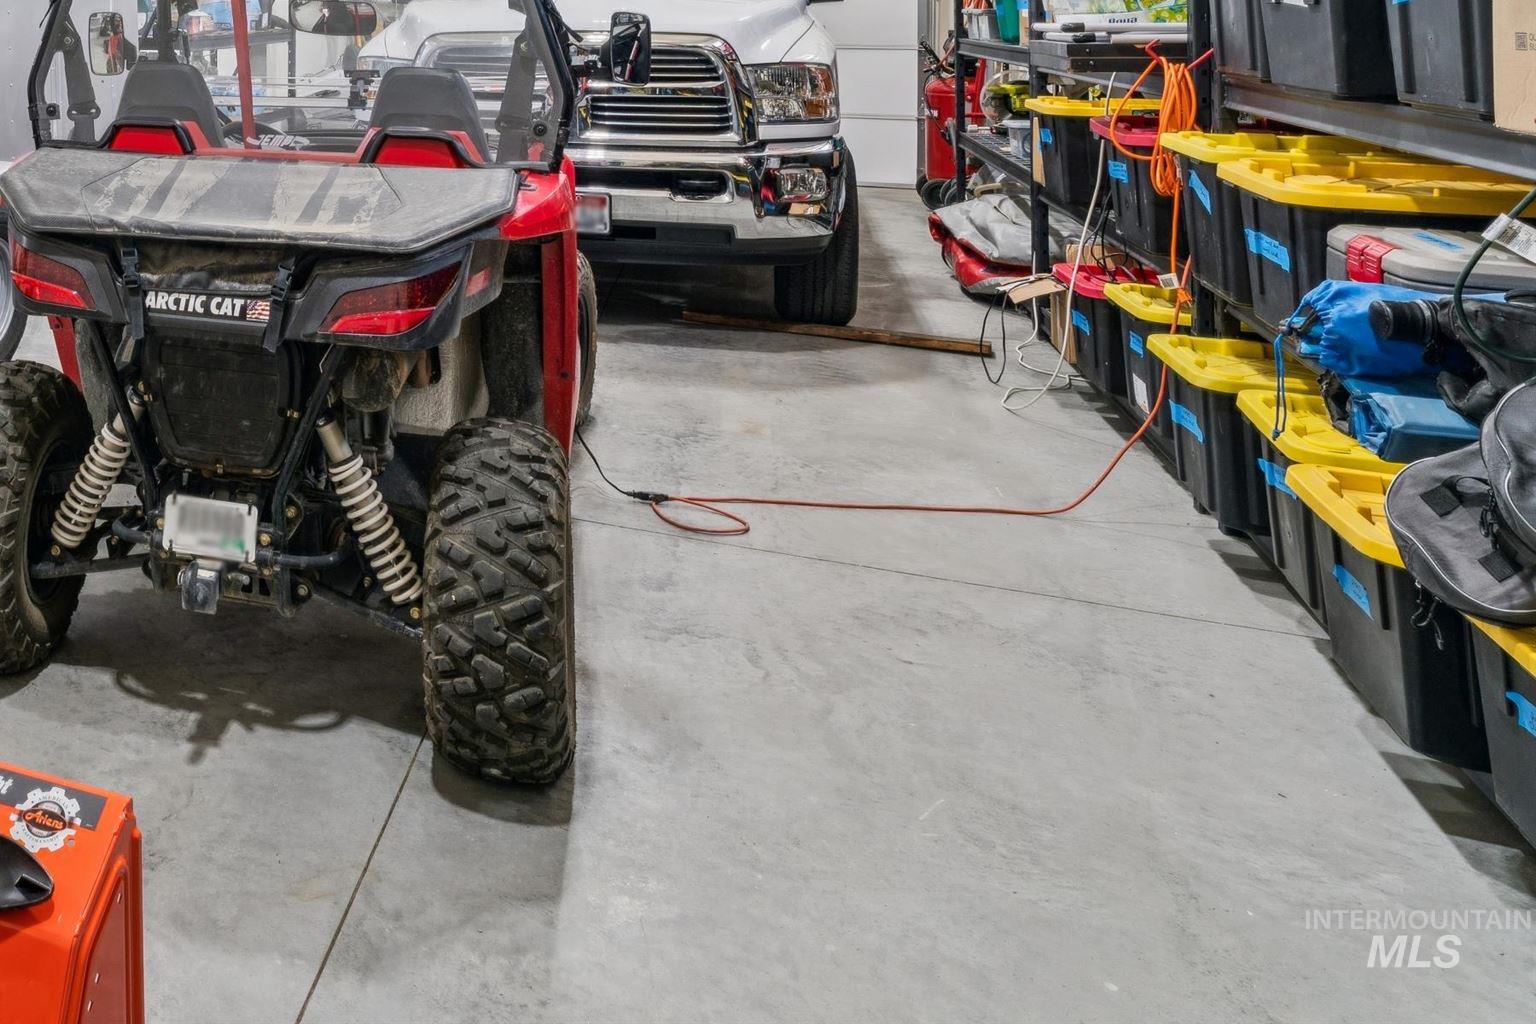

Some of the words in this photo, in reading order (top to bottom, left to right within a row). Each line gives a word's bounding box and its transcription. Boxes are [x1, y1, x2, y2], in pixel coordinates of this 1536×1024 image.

[145, 291, 206, 313] ARCTIC
[210, 297, 245, 317] CAT
[25, 810, 64, 830] Ariens
